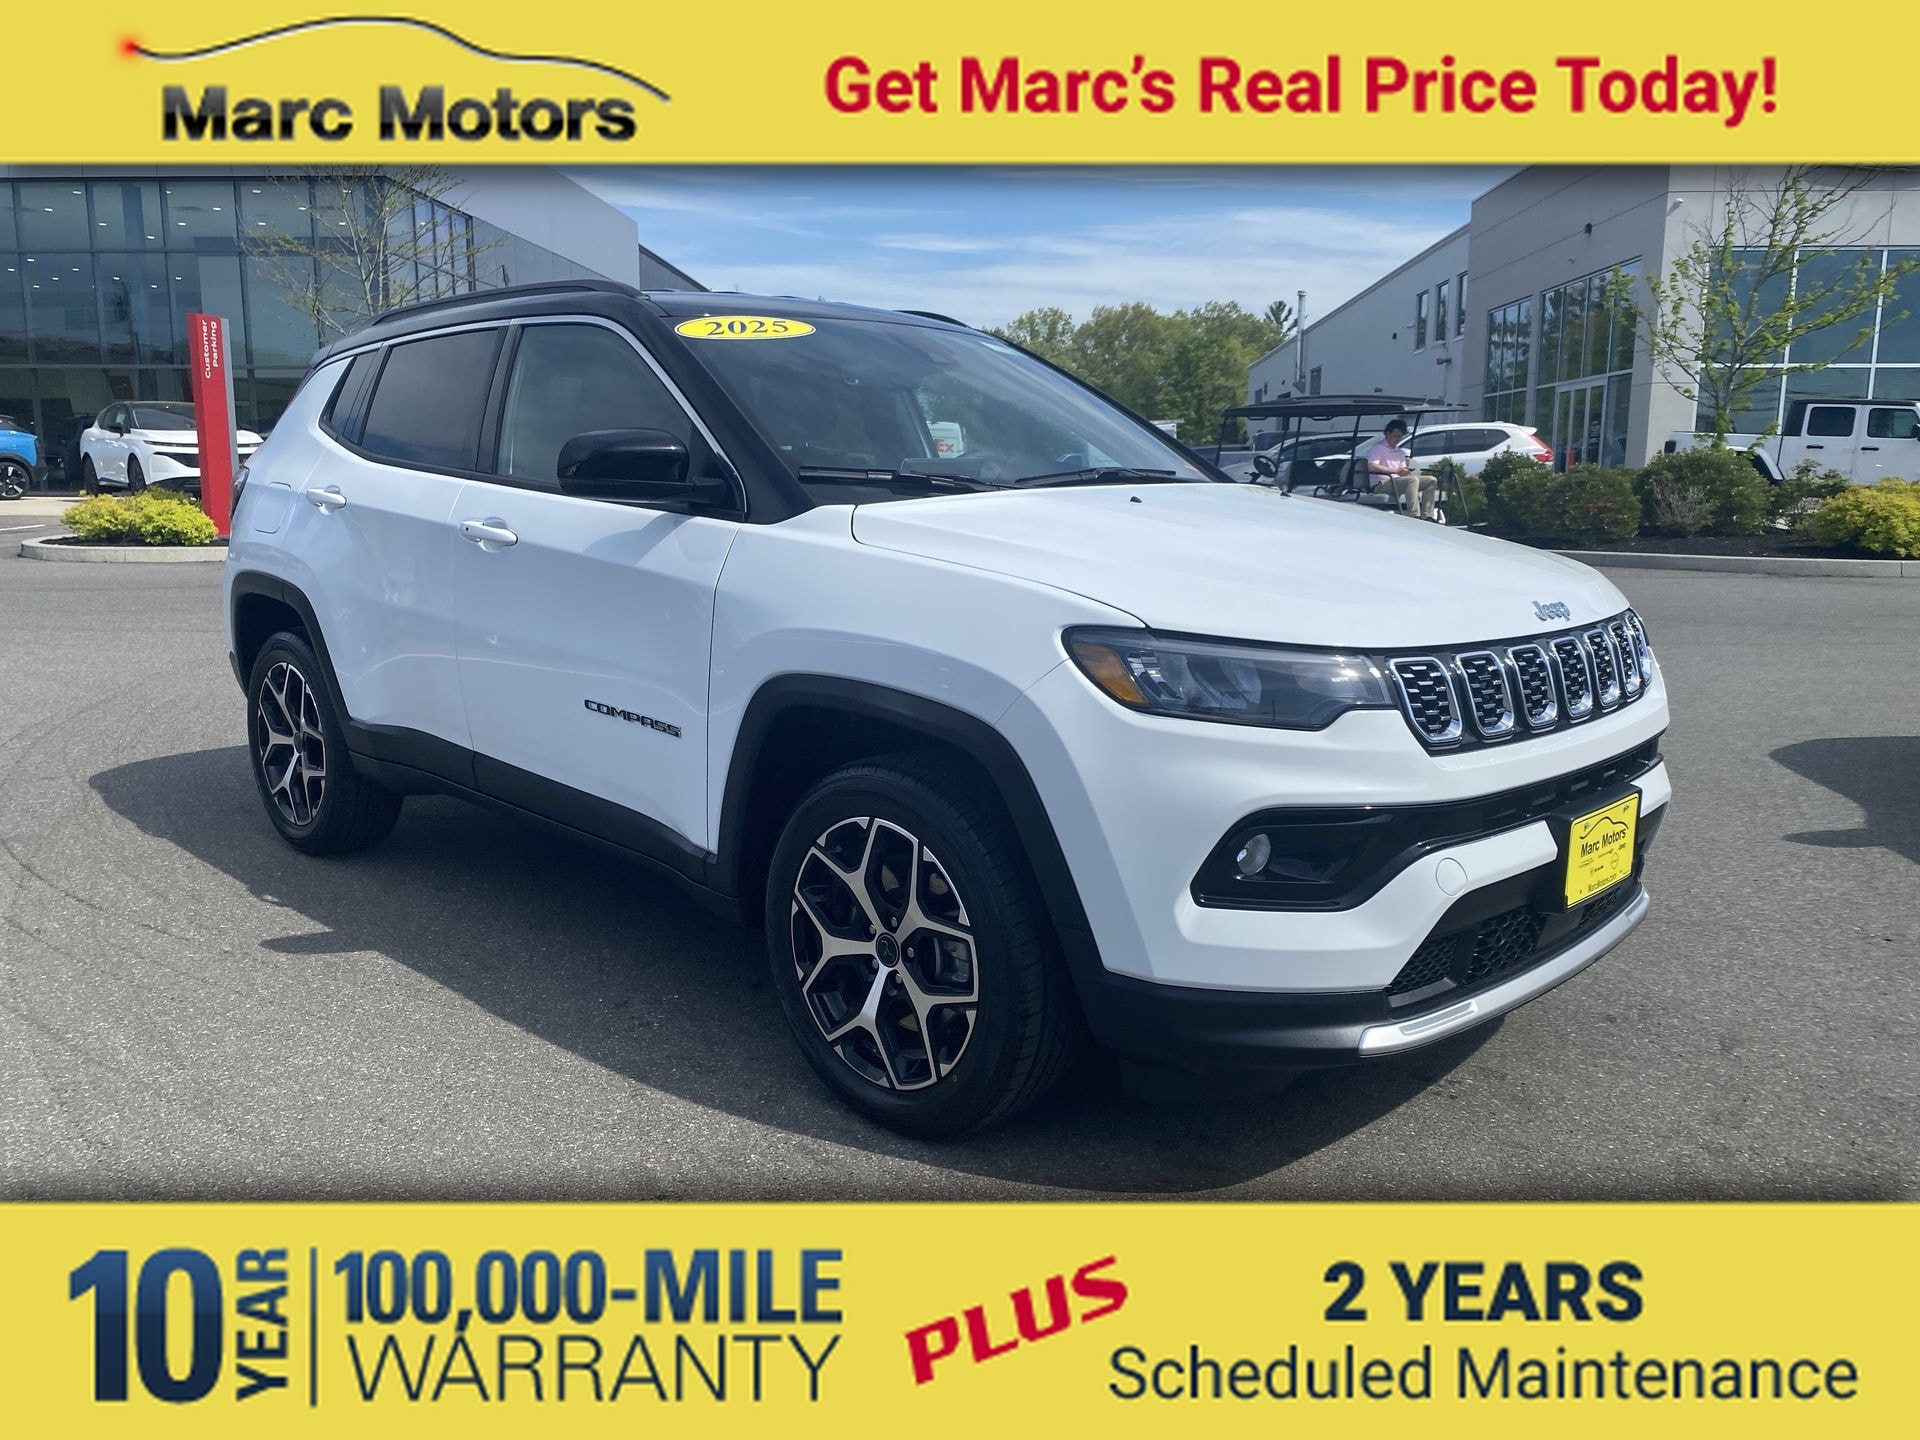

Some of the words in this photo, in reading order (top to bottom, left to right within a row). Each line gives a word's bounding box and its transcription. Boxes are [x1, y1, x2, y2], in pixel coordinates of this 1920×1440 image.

[210, 321, 219, 368] Parking
[705, 320, 789, 336] 2025
[201, 320, 211, 379] Customer
[1532, 600, 1571, 622] Jeep
[584, 699, 682, 739] COMPASS
[1581, 841, 1599, 858] Marc
[1602, 828, 1626, 848] Motors
